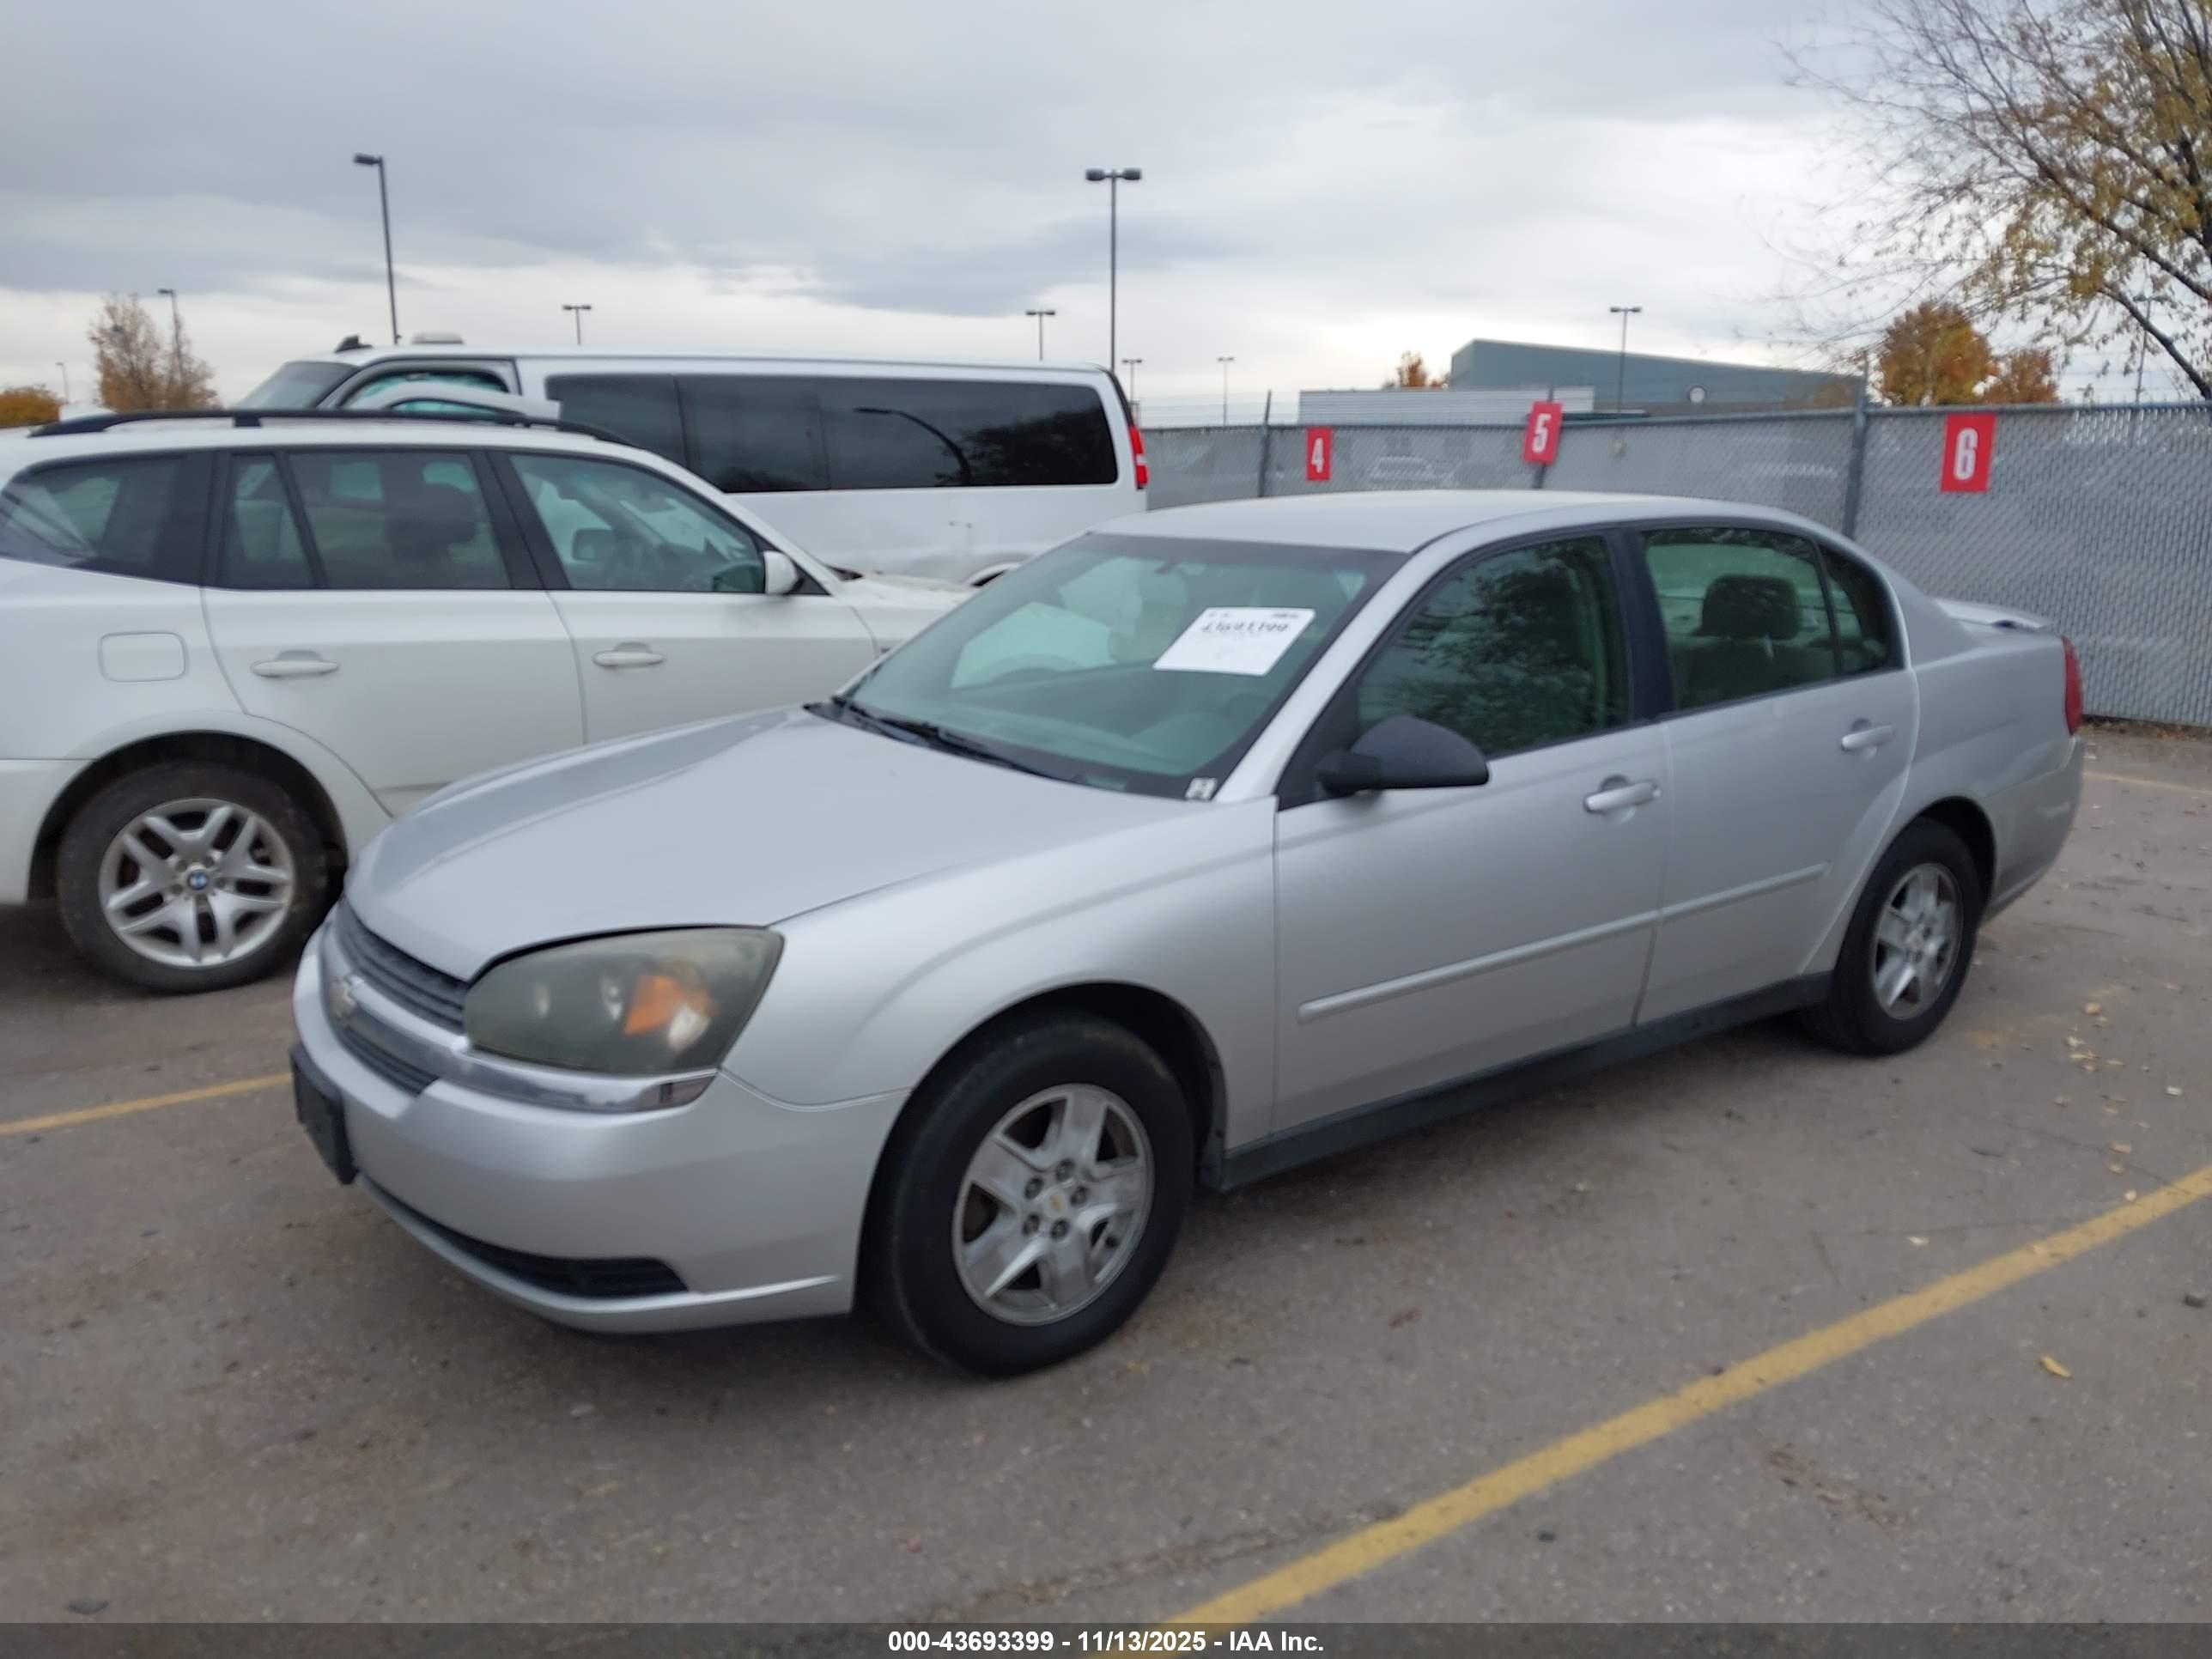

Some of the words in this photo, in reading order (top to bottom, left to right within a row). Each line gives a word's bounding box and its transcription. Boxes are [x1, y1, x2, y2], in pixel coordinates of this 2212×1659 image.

[1533, 413, 1552, 453] 5
[1310, 438, 1324, 473] 4
[1954, 428, 1978, 480] 6
